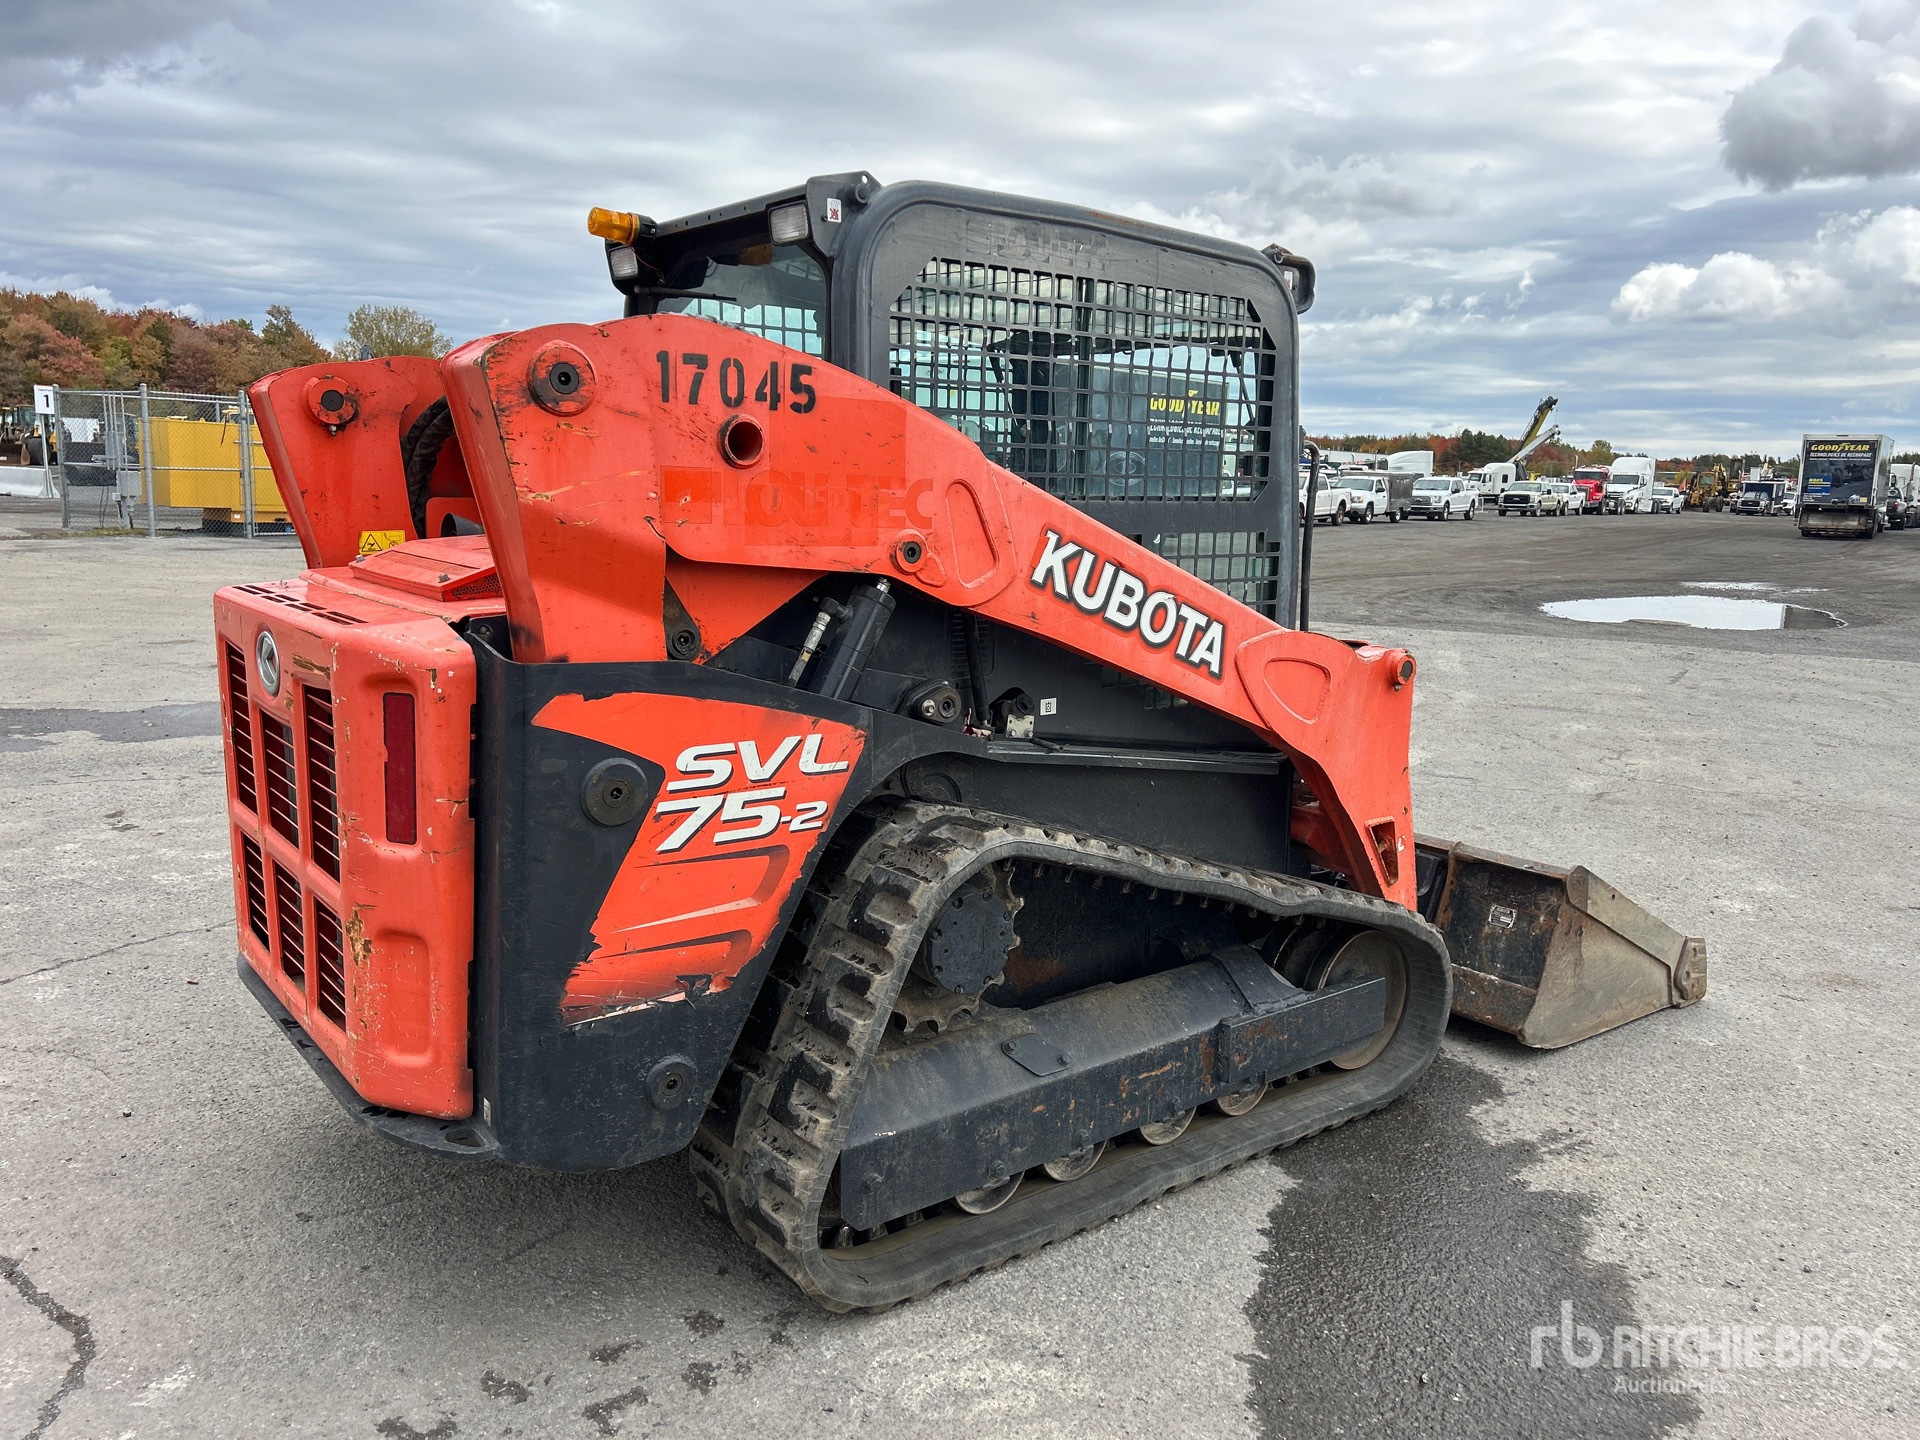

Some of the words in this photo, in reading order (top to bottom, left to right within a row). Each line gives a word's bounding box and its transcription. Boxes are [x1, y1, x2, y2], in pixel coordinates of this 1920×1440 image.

[44, 394, 49, 408] 1
[656, 350, 816, 414] 17045
[1811, 443, 1870, 452] GOODYEAR
[1031, 530, 1223, 675] KUBOTA
[666, 733, 849, 793] SVL
[655, 787, 828, 854] 75-2
